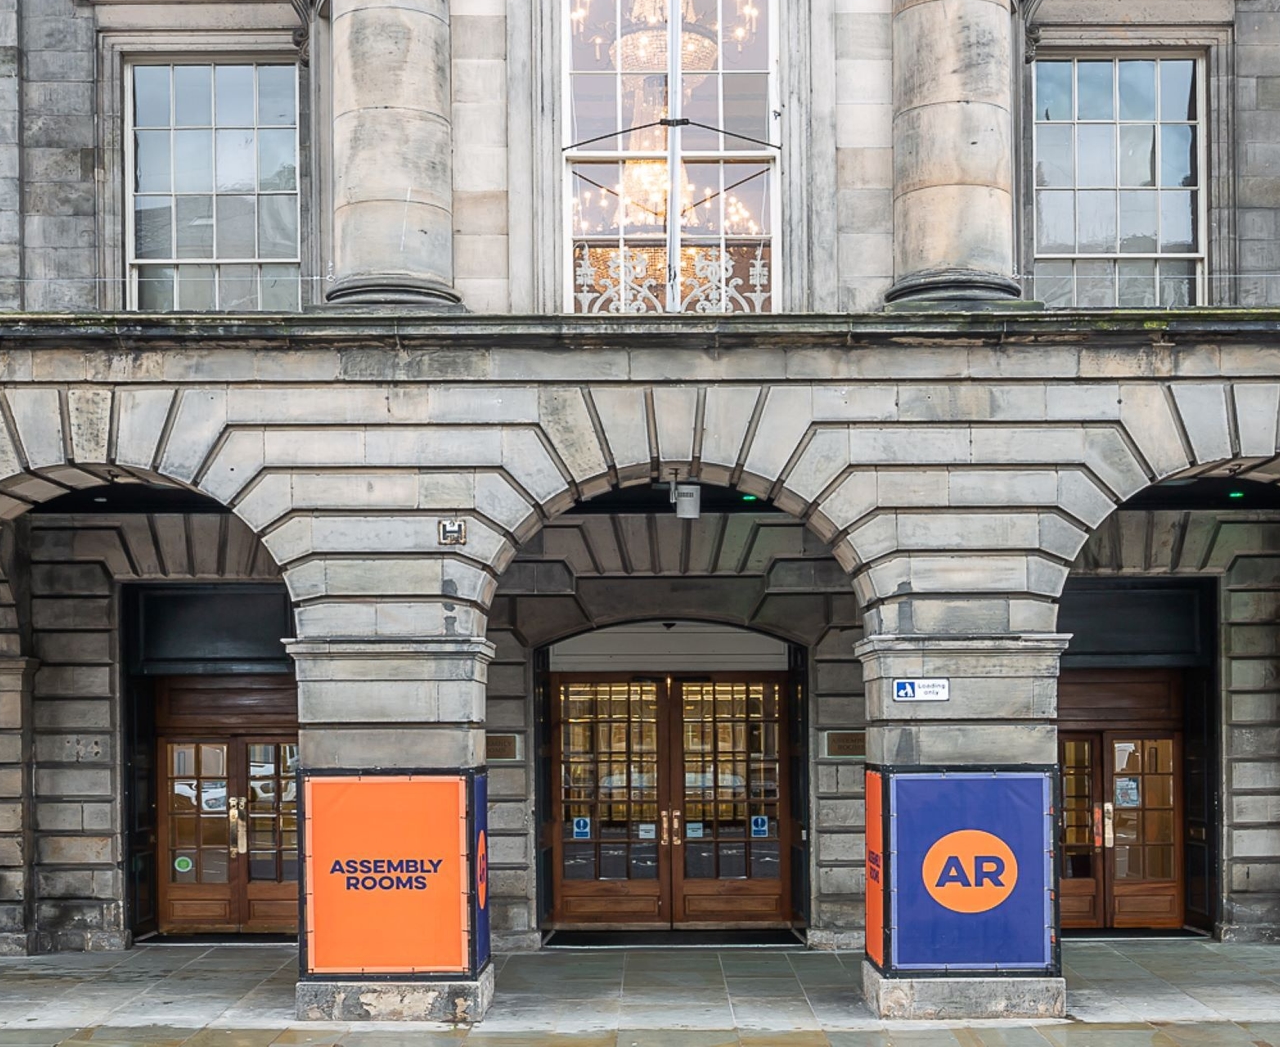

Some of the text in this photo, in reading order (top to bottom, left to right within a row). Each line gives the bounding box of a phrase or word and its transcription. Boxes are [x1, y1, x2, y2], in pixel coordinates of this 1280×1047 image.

[330, 859, 443, 874] ASSEMBLY
[935, 856, 1005, 887] AR
[346, 876, 427, 890] ROOMS
